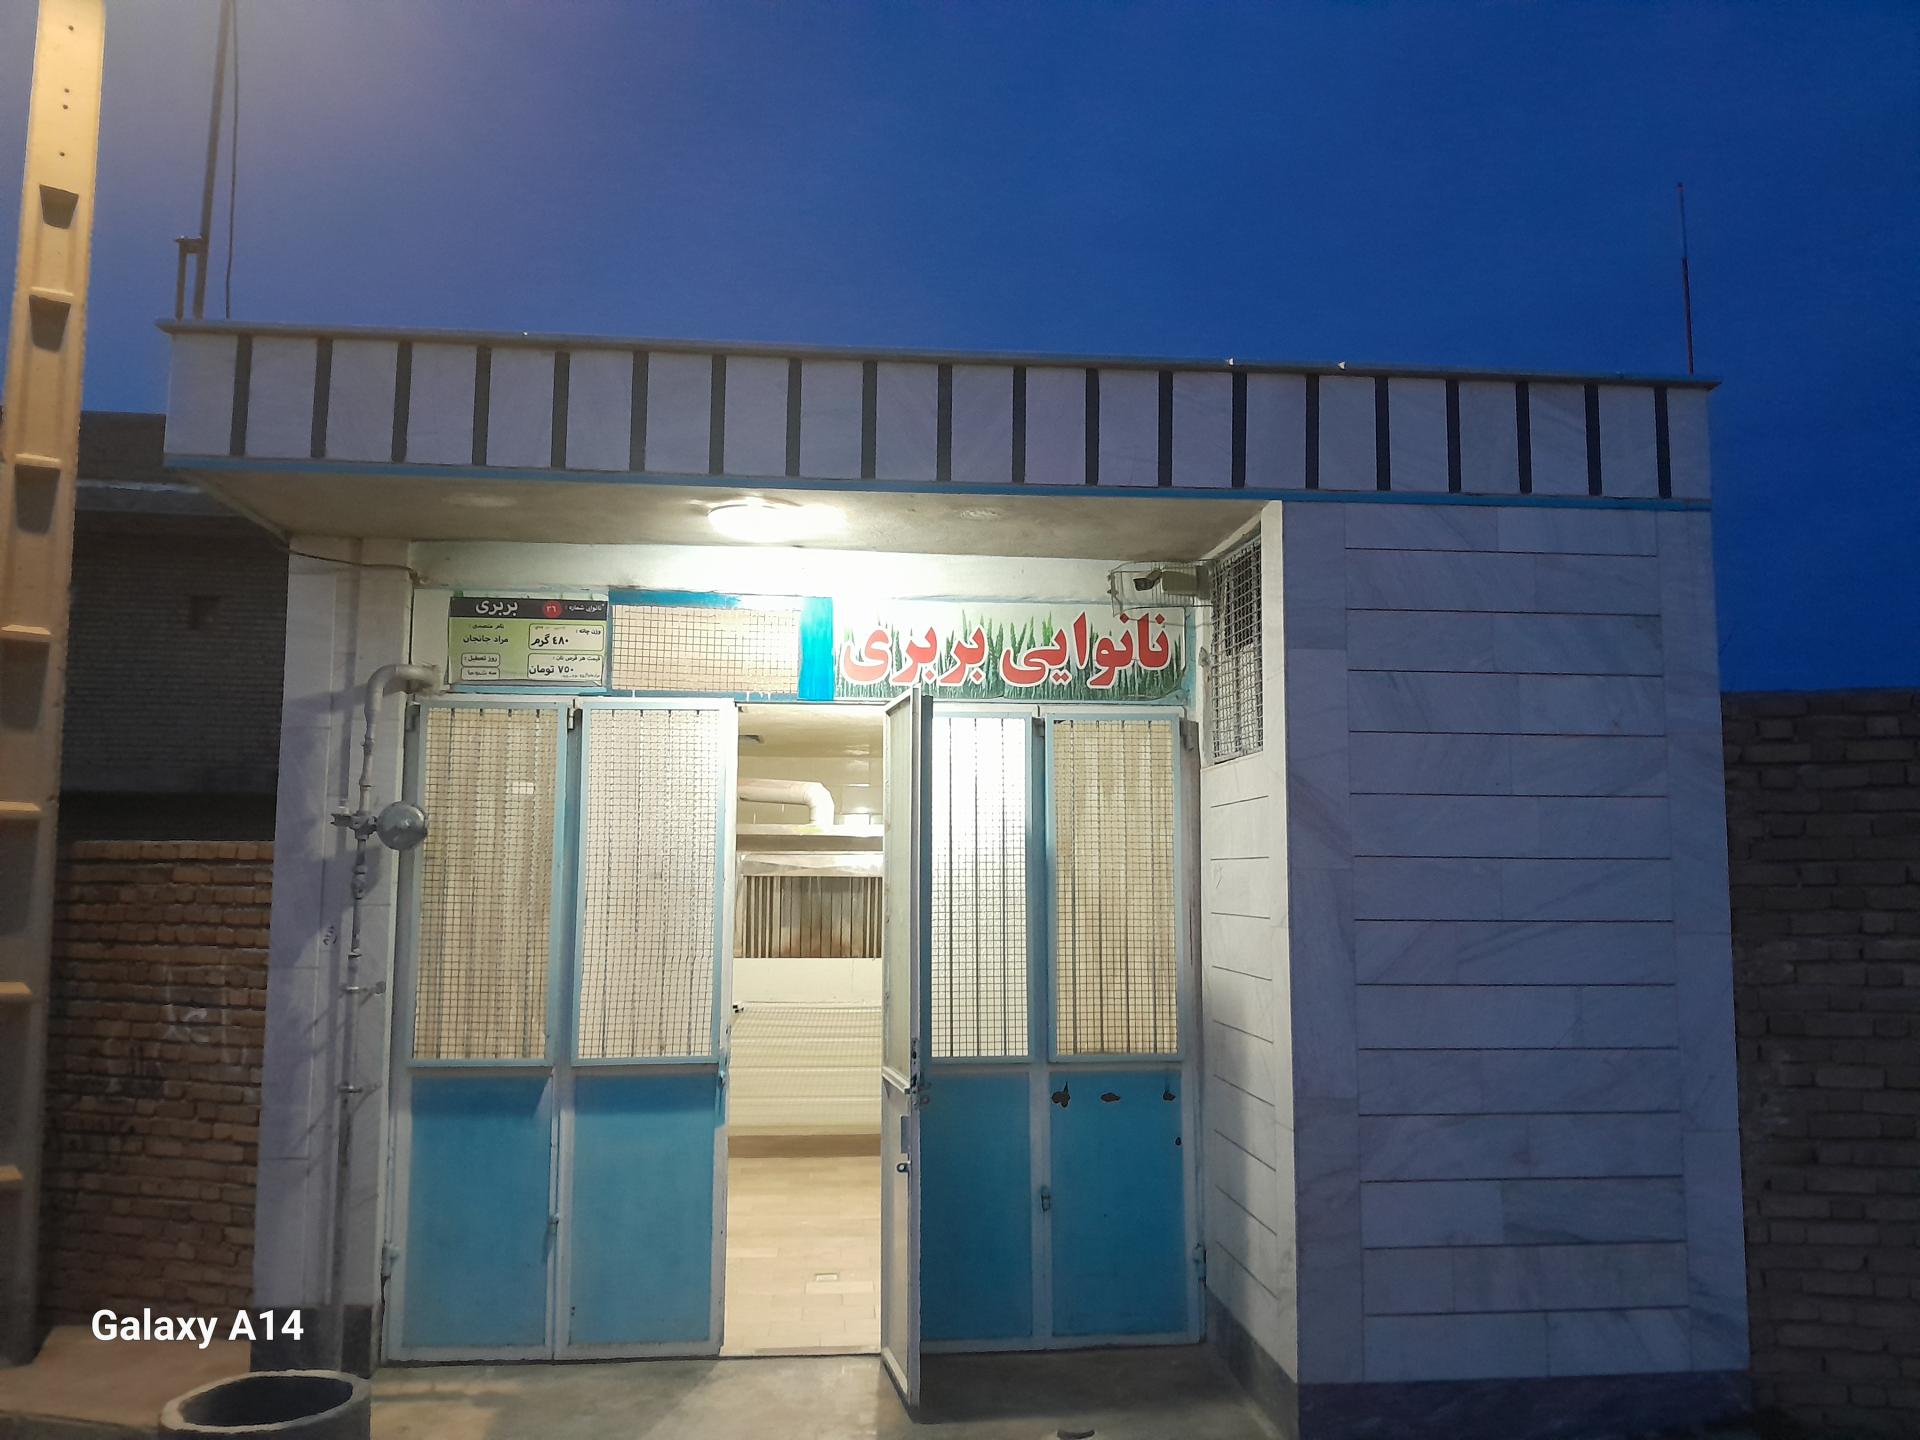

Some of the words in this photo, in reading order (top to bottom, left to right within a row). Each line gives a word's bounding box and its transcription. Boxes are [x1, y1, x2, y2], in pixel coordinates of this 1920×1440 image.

[475, 600, 518, 616] بربری
[494, 635, 509, 645] مراد
[531, 633, 550, 647] گرم
[842, 625, 987, 687] بربری
[1001, 611, 1170, 688] نانوایی
[529, 665, 555, 676] تومان
